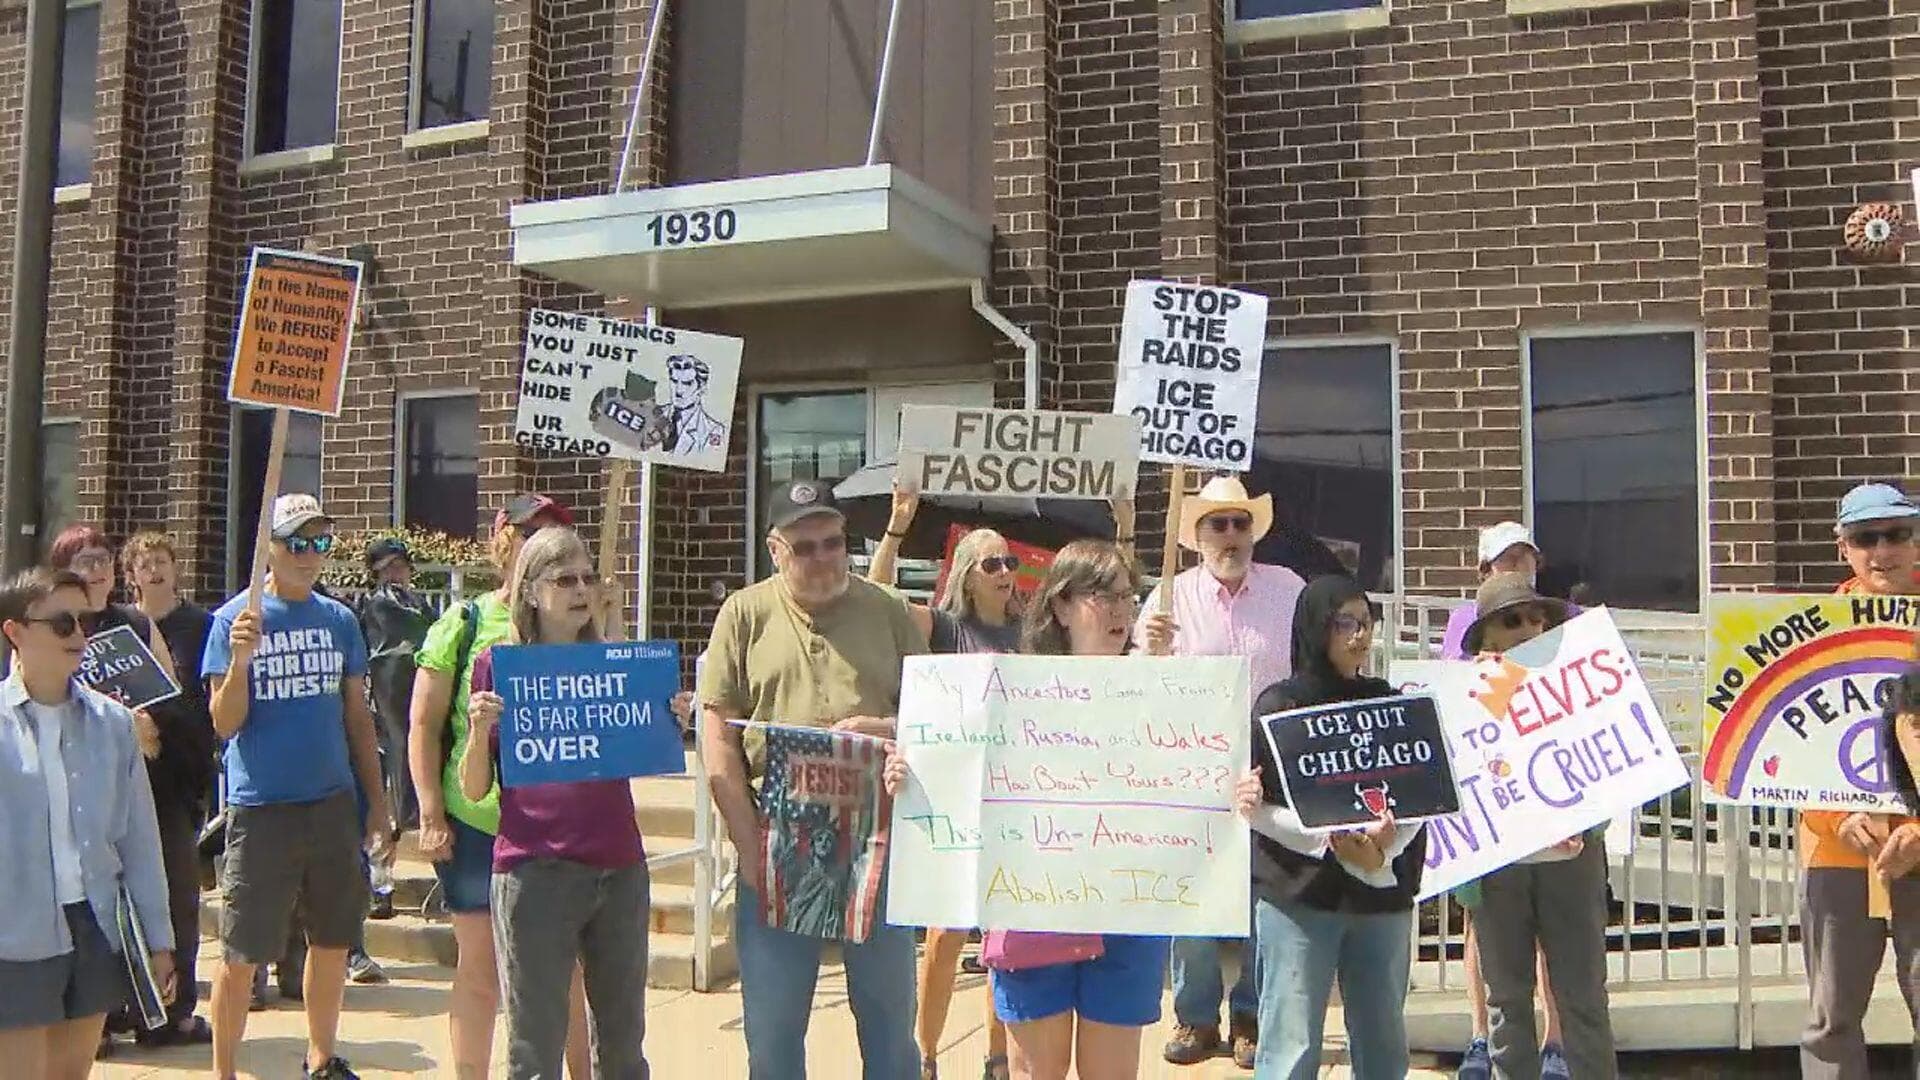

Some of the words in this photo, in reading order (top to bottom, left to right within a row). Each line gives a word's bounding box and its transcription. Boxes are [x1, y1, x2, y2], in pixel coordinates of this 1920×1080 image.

[646, 209, 736, 246] 1930
[258, 277, 271, 291] In
[278, 278, 301, 295] the
[306, 281, 349, 301] Name
[1152, 286, 1241, 316] STOP
[253, 297, 267, 310] of
[273, 300, 347, 326] Humanity,
[254, 315, 276, 331] We
[281, 321, 341, 342] REFUSE
[531, 311, 588, 332] SOME
[598, 320, 676, 345] THINGS
[1163, 313, 1227, 344] THE
[258, 337, 272, 352] to
[276, 339, 329, 362] Accept
[530, 333, 574, 353] YOU
[586, 343, 638, 363] JUST
[1141, 339, 1242, 372] RAIDS
[255, 361, 264, 373] a
[268, 360, 324, 381] Fascist
[527, 358, 593, 380] CAN'T
[252, 378, 321, 403] America!
[522, 381, 571, 402] HIDE
[1156, 379, 1215, 411] ICE
[533, 414, 563, 432] UR
[606, 403, 647, 432] ICE
[953, 411, 1093, 452] FIGHT
[1131, 405, 1190, 432] OUT
[1197, 412, 1238, 436] OF
[515, 431, 612, 457] GESTAPO
[1140, 430, 1247, 462] HICAGO
[921, 453, 1115, 496] FASCISM
[255, 628, 333, 656] MARCH
[634, 647, 672, 659] Illinois
[253, 654, 300, 677] FOR
[303, 651, 344, 674] OUR
[1706, 667, 1744, 714] NO
[1744, 604, 1831, 668] MORE
[256, 675, 320, 700] LIVES
[509, 676, 552, 702] THE
[556, 672, 627, 699] FIGHT
[982, 666, 1091, 702] Ancestors
[1462, 722, 1501, 750] TO
[1506, 649, 1631, 737] ELVIS:
[513, 707, 533, 732] IS
[539, 705, 580, 731] FAR
[585, 701, 651, 728] FROM
[1303, 711, 1350, 739] ICE
[1356, 706, 1405, 731] OUT
[515, 735, 600, 764] OVER
[1022, 719, 1099, 748] Russia,
[1109, 729, 1141, 747] and
[1146, 722, 1230, 752] Wales
[1350, 731, 1374, 748] OF
[1298, 740, 1432, 777] CHICAGO
[988, 762, 1031, 793] How
[1033, 764, 1099, 791] Bout
[1491, 778, 1526, 810] BE
[1752, 786, 1809, 802] MARTIN
[1819, 791, 1884, 808] RICHARD,
[902, 814, 982, 845] This
[1001, 822, 1024, 841] is
[985, 867, 1105, 904] Abolish
[1111, 869, 1200, 907] ICE
